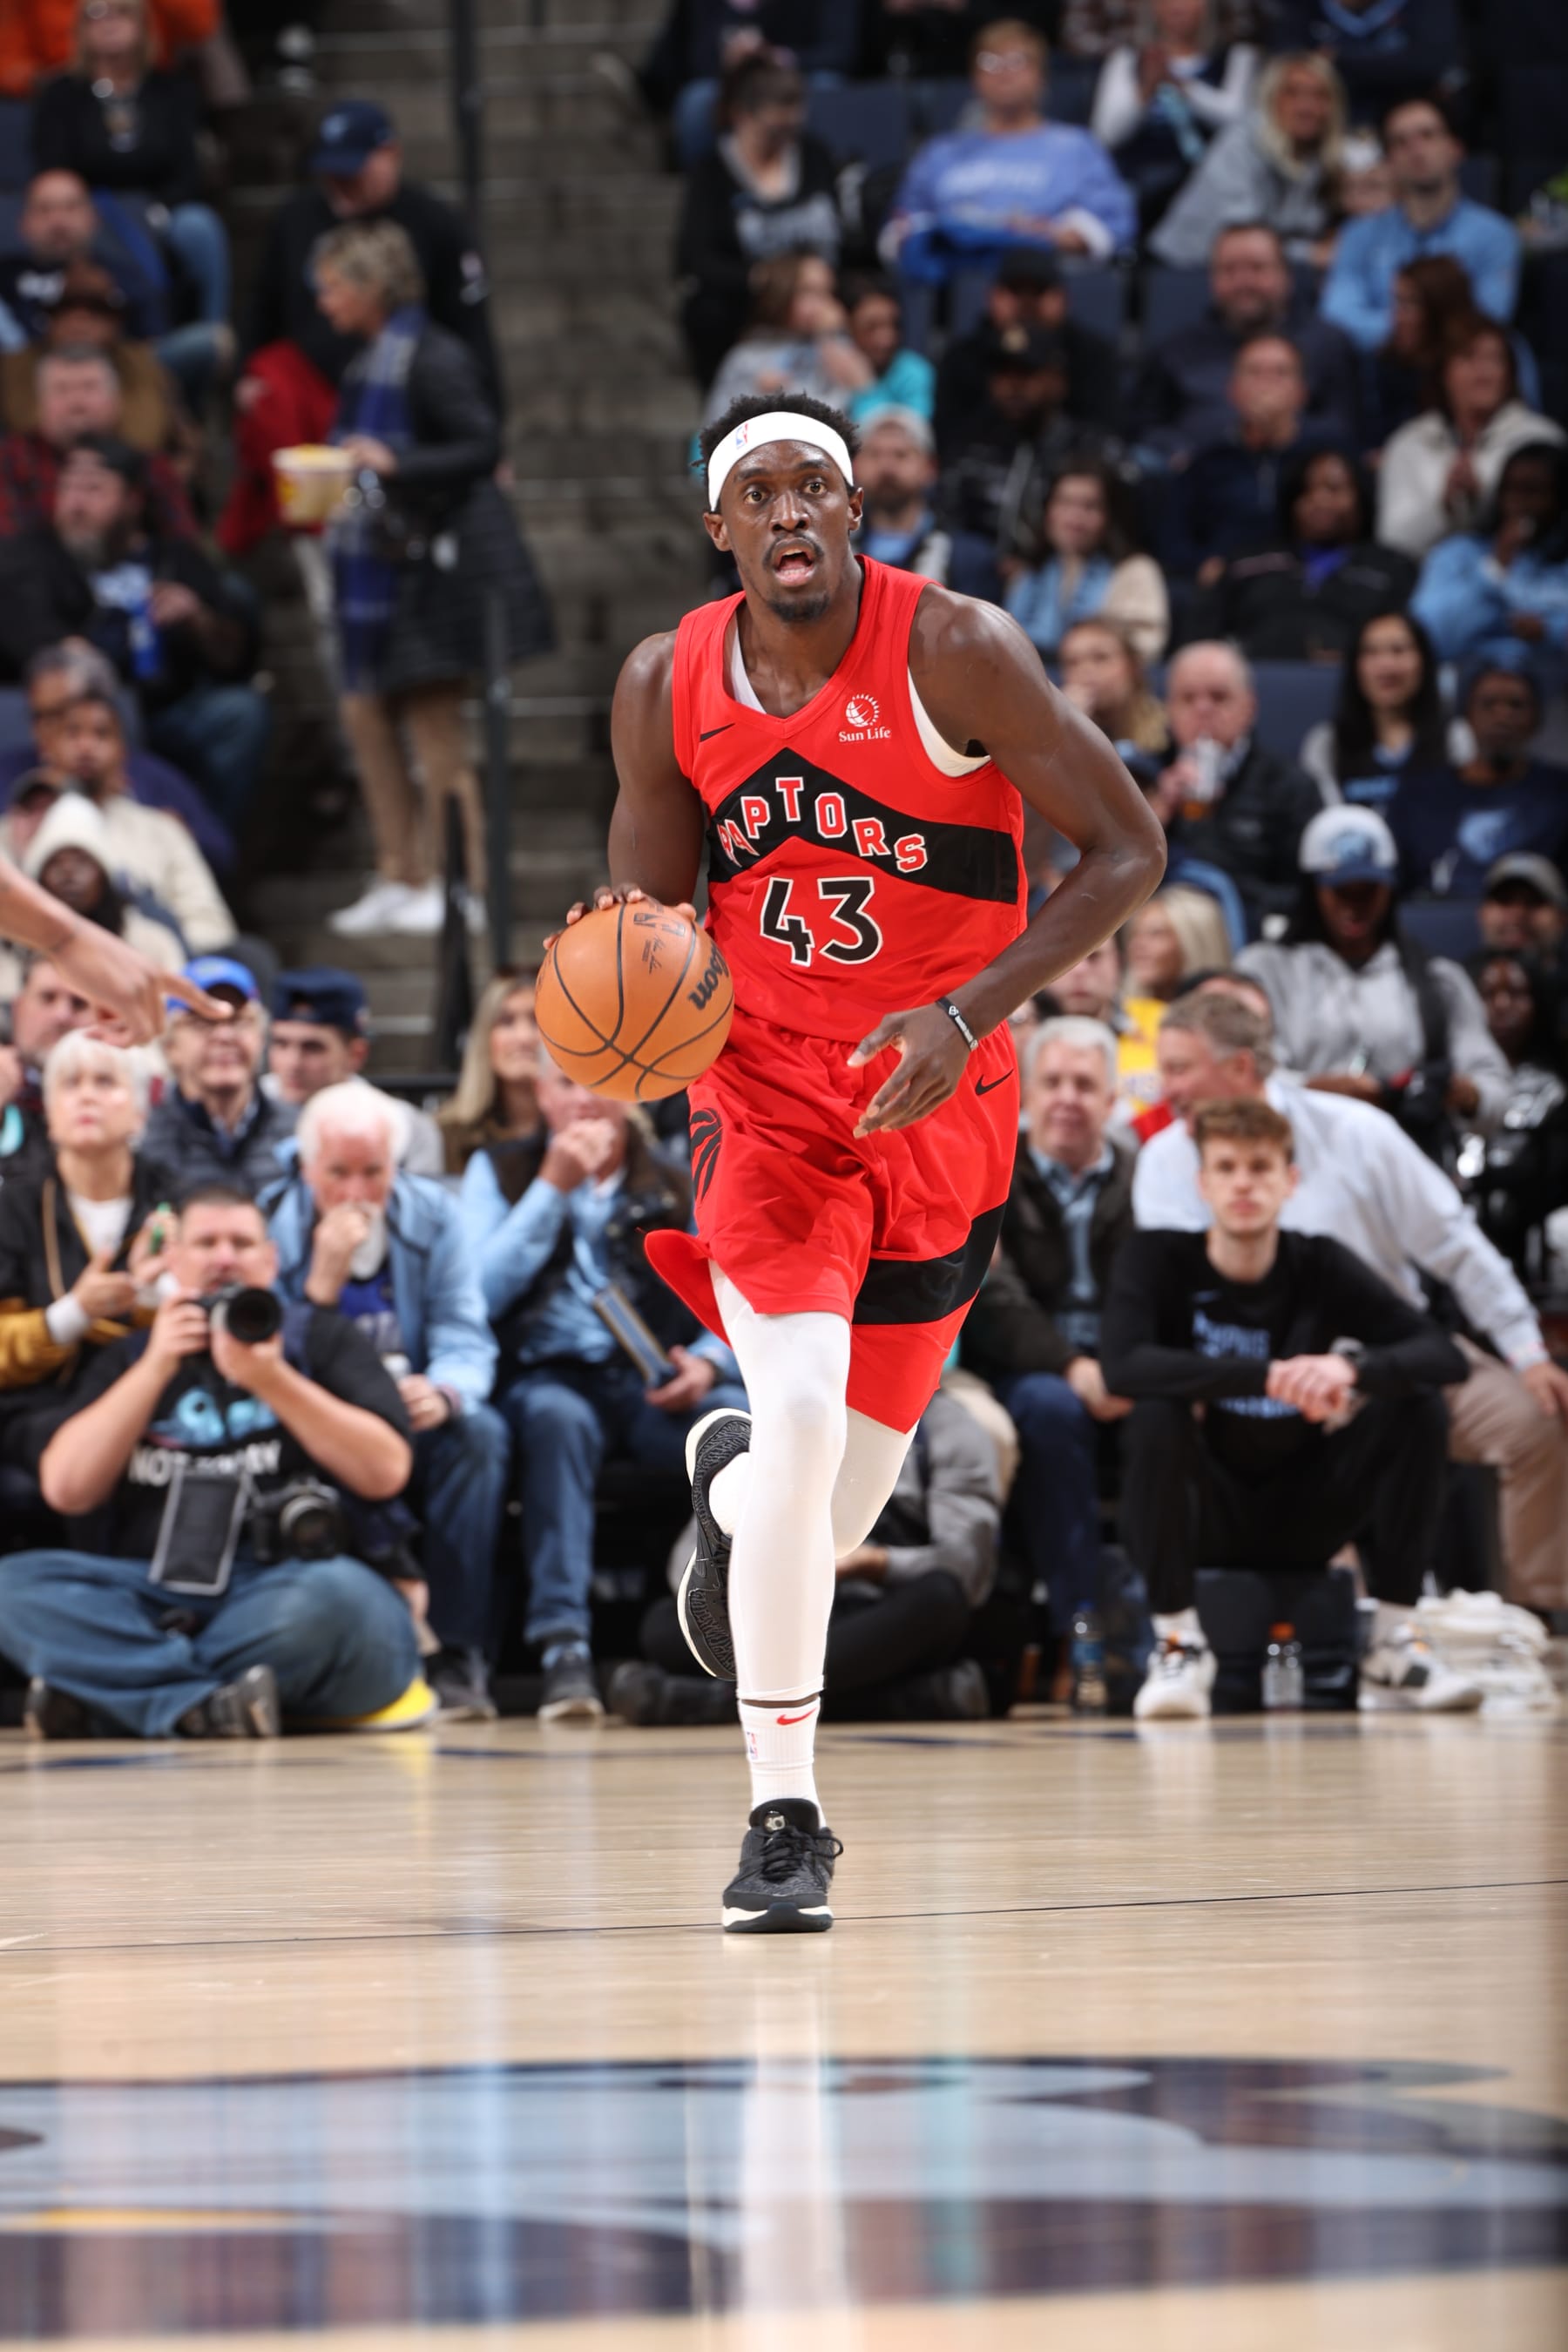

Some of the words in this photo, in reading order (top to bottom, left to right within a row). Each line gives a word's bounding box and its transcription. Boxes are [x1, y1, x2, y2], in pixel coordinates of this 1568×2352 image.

[838, 731, 864, 743] Sun
[867, 726, 892, 740] Life
[717, 776, 929, 874] RAPTORS
[760, 875, 883, 968] 43
